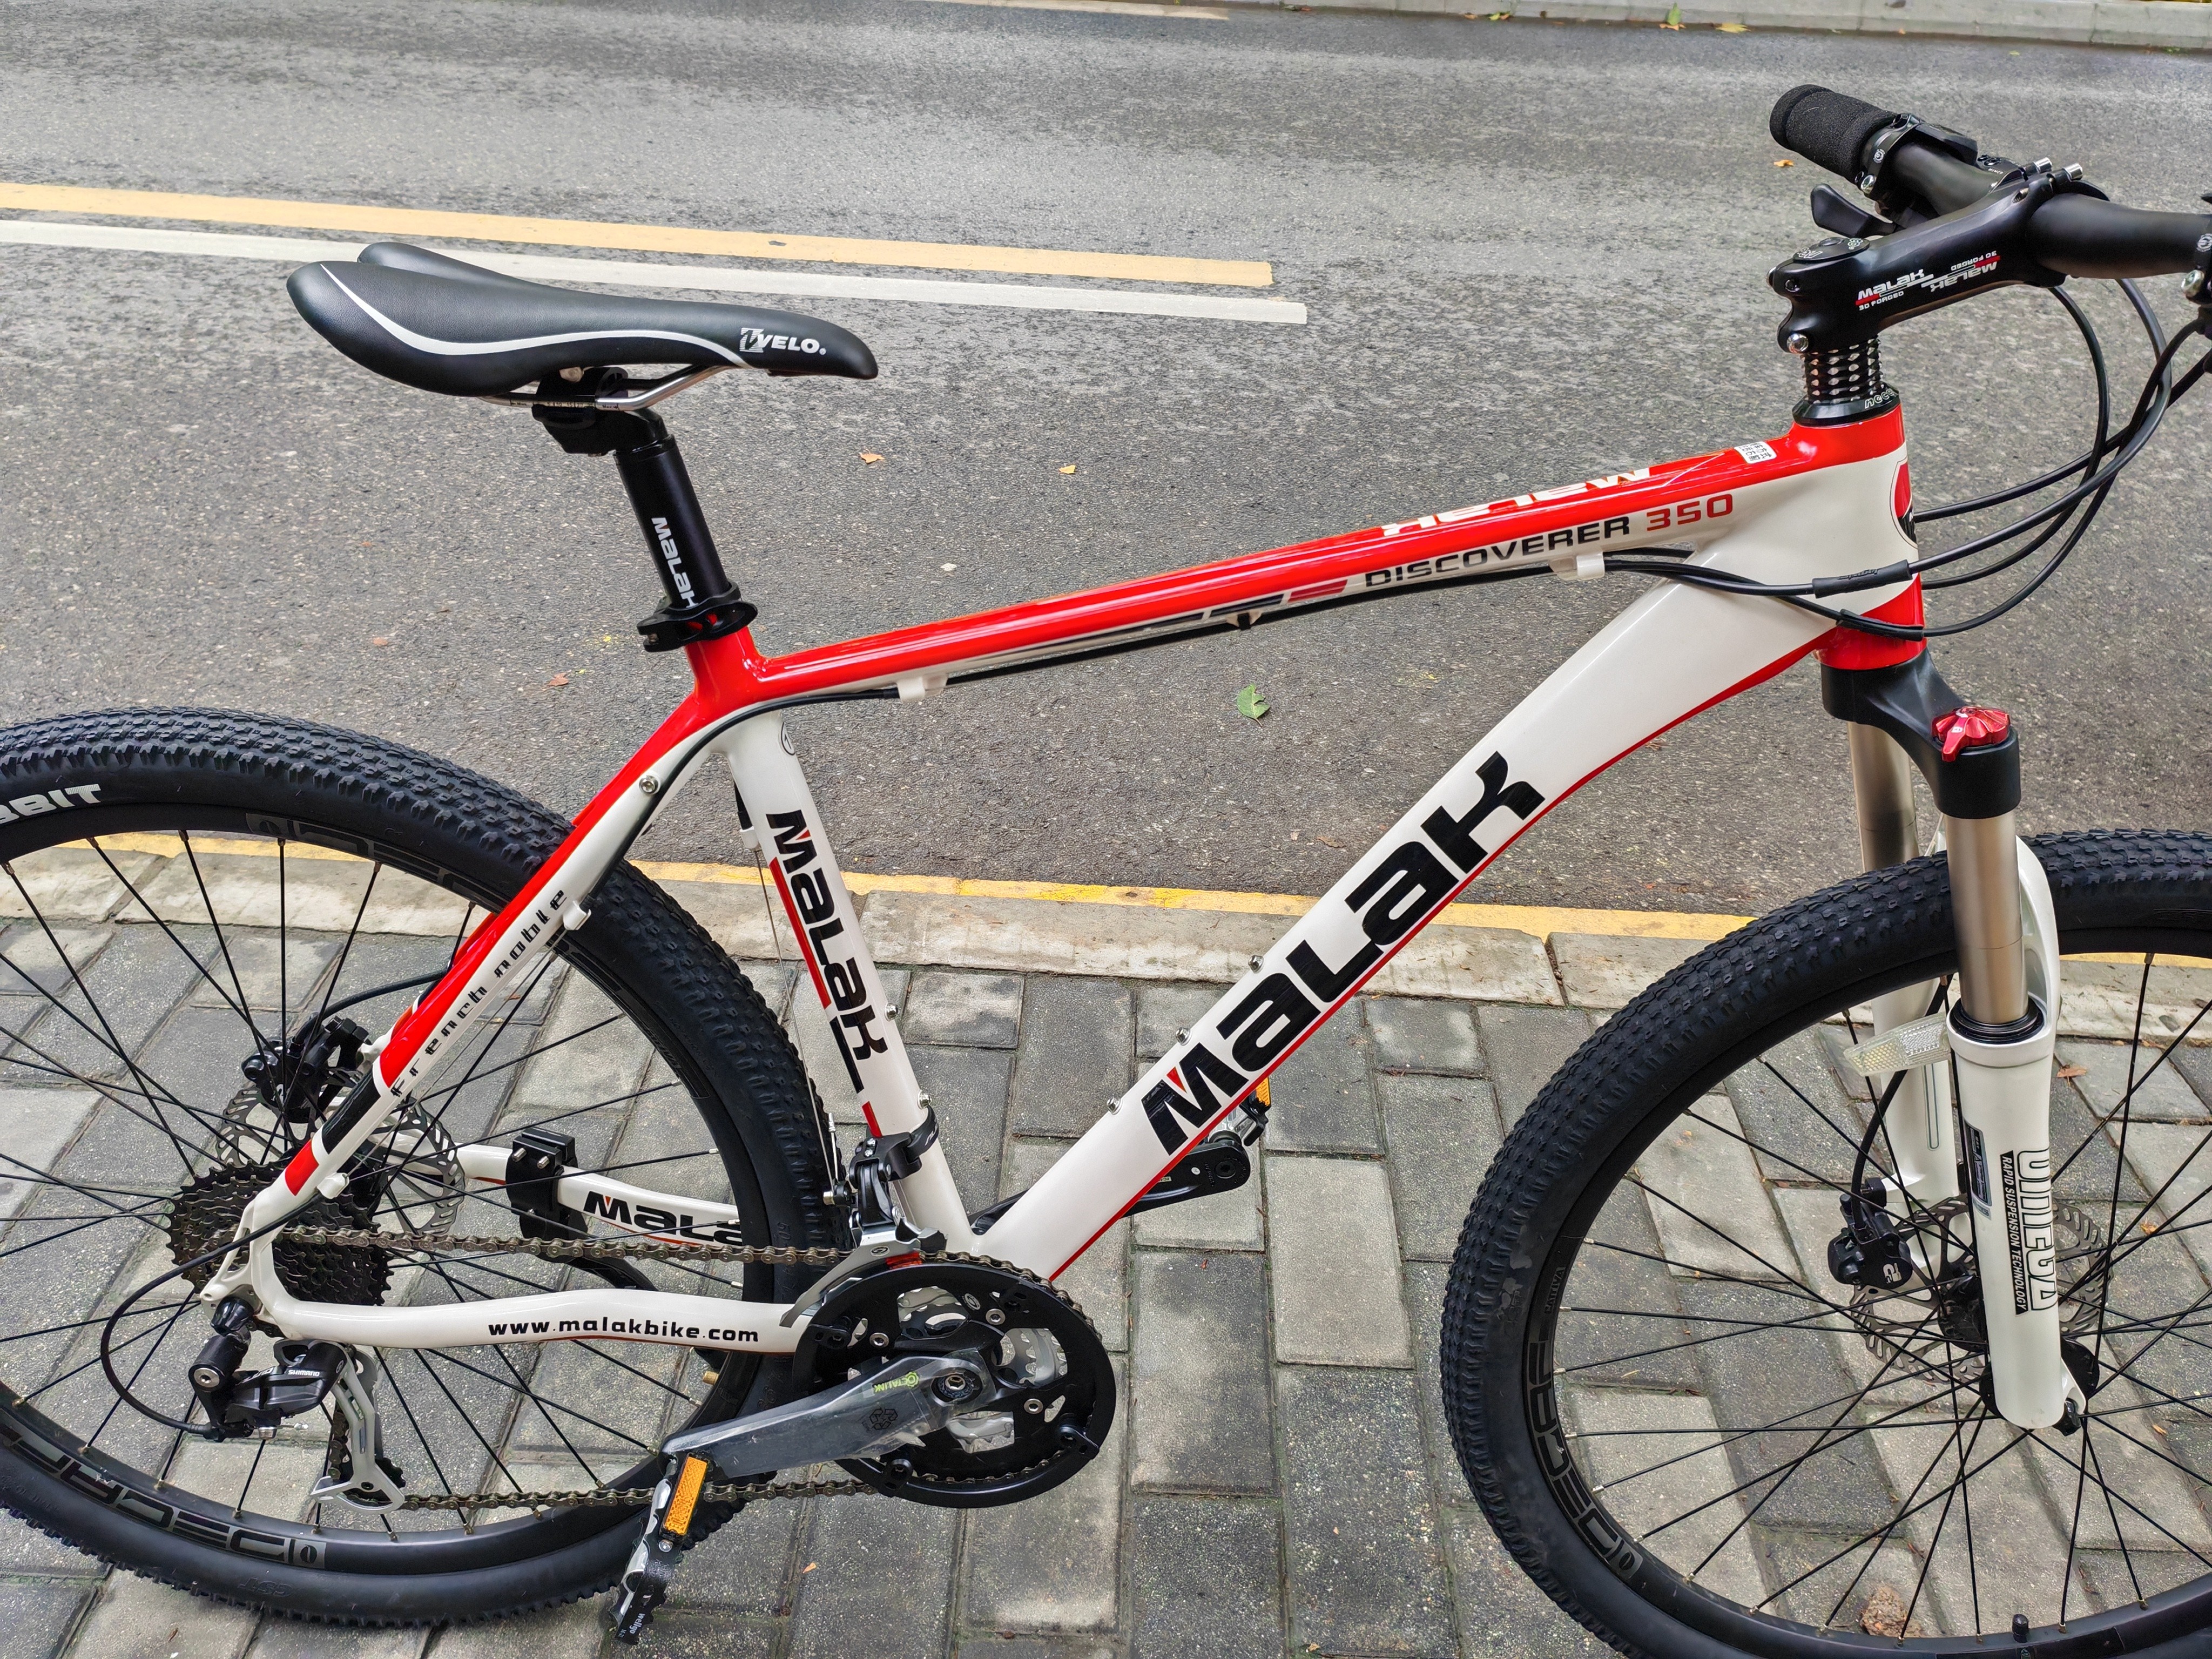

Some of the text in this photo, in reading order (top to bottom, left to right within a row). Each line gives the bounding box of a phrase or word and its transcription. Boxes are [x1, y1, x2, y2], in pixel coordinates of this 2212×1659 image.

[1365, 494, 1732, 588] DISCOVERER 350
[2002, 1156, 2027, 1311] RAPID SUSPENSION TECHNOLOGY
[488, 1317, 759, 1344] www.malakbike.com
[288, 1369, 320, 1377] SHIMANO
